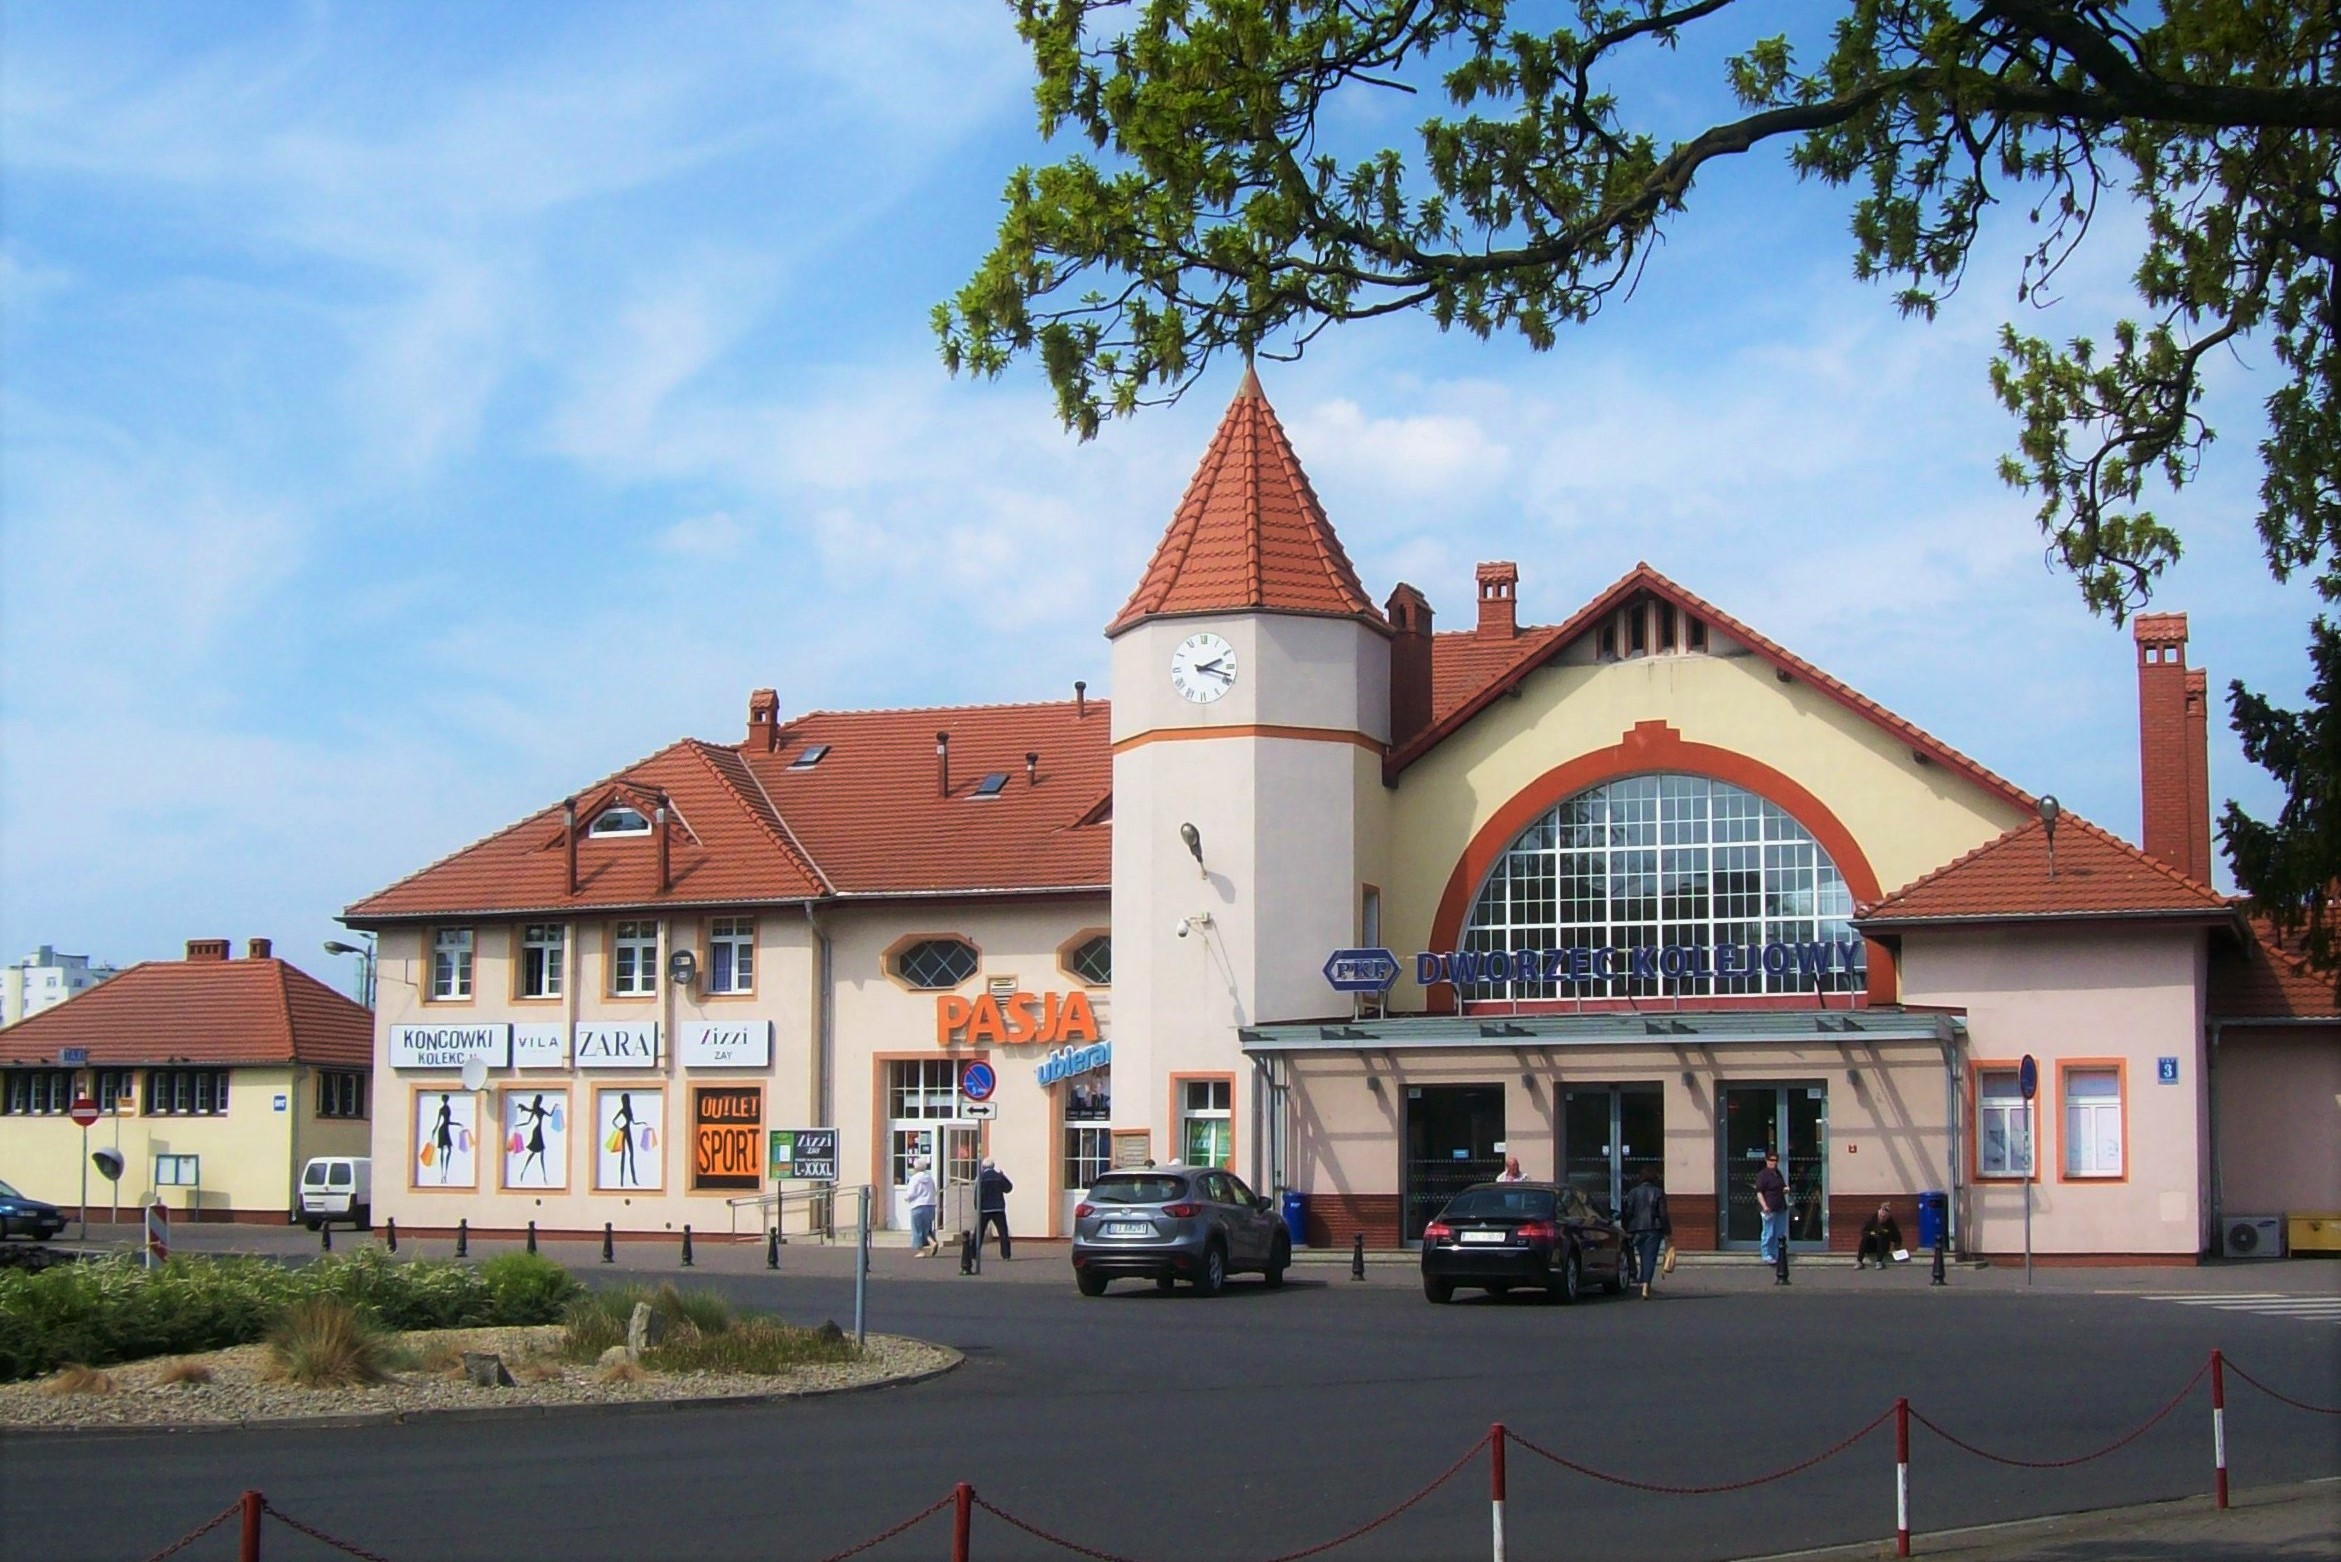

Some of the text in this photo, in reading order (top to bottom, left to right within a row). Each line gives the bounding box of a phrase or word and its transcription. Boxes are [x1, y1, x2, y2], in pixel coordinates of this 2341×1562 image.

[1336, 961, 1391, 980] PKP
[1415, 940, 1860, 986] DWORZEC KOLEJOWY
[936, 991, 1099, 1045] PASJA
[518, 1036, 559, 1048] VILA
[578, 1030, 651, 1057] ZARA
[2163, 1063, 2173, 1078] 3
[701, 1096, 760, 1119] OUTLET
[698, 1128, 760, 1173] SPORT
[794, 1162, 834, 1176] L-XXXL
